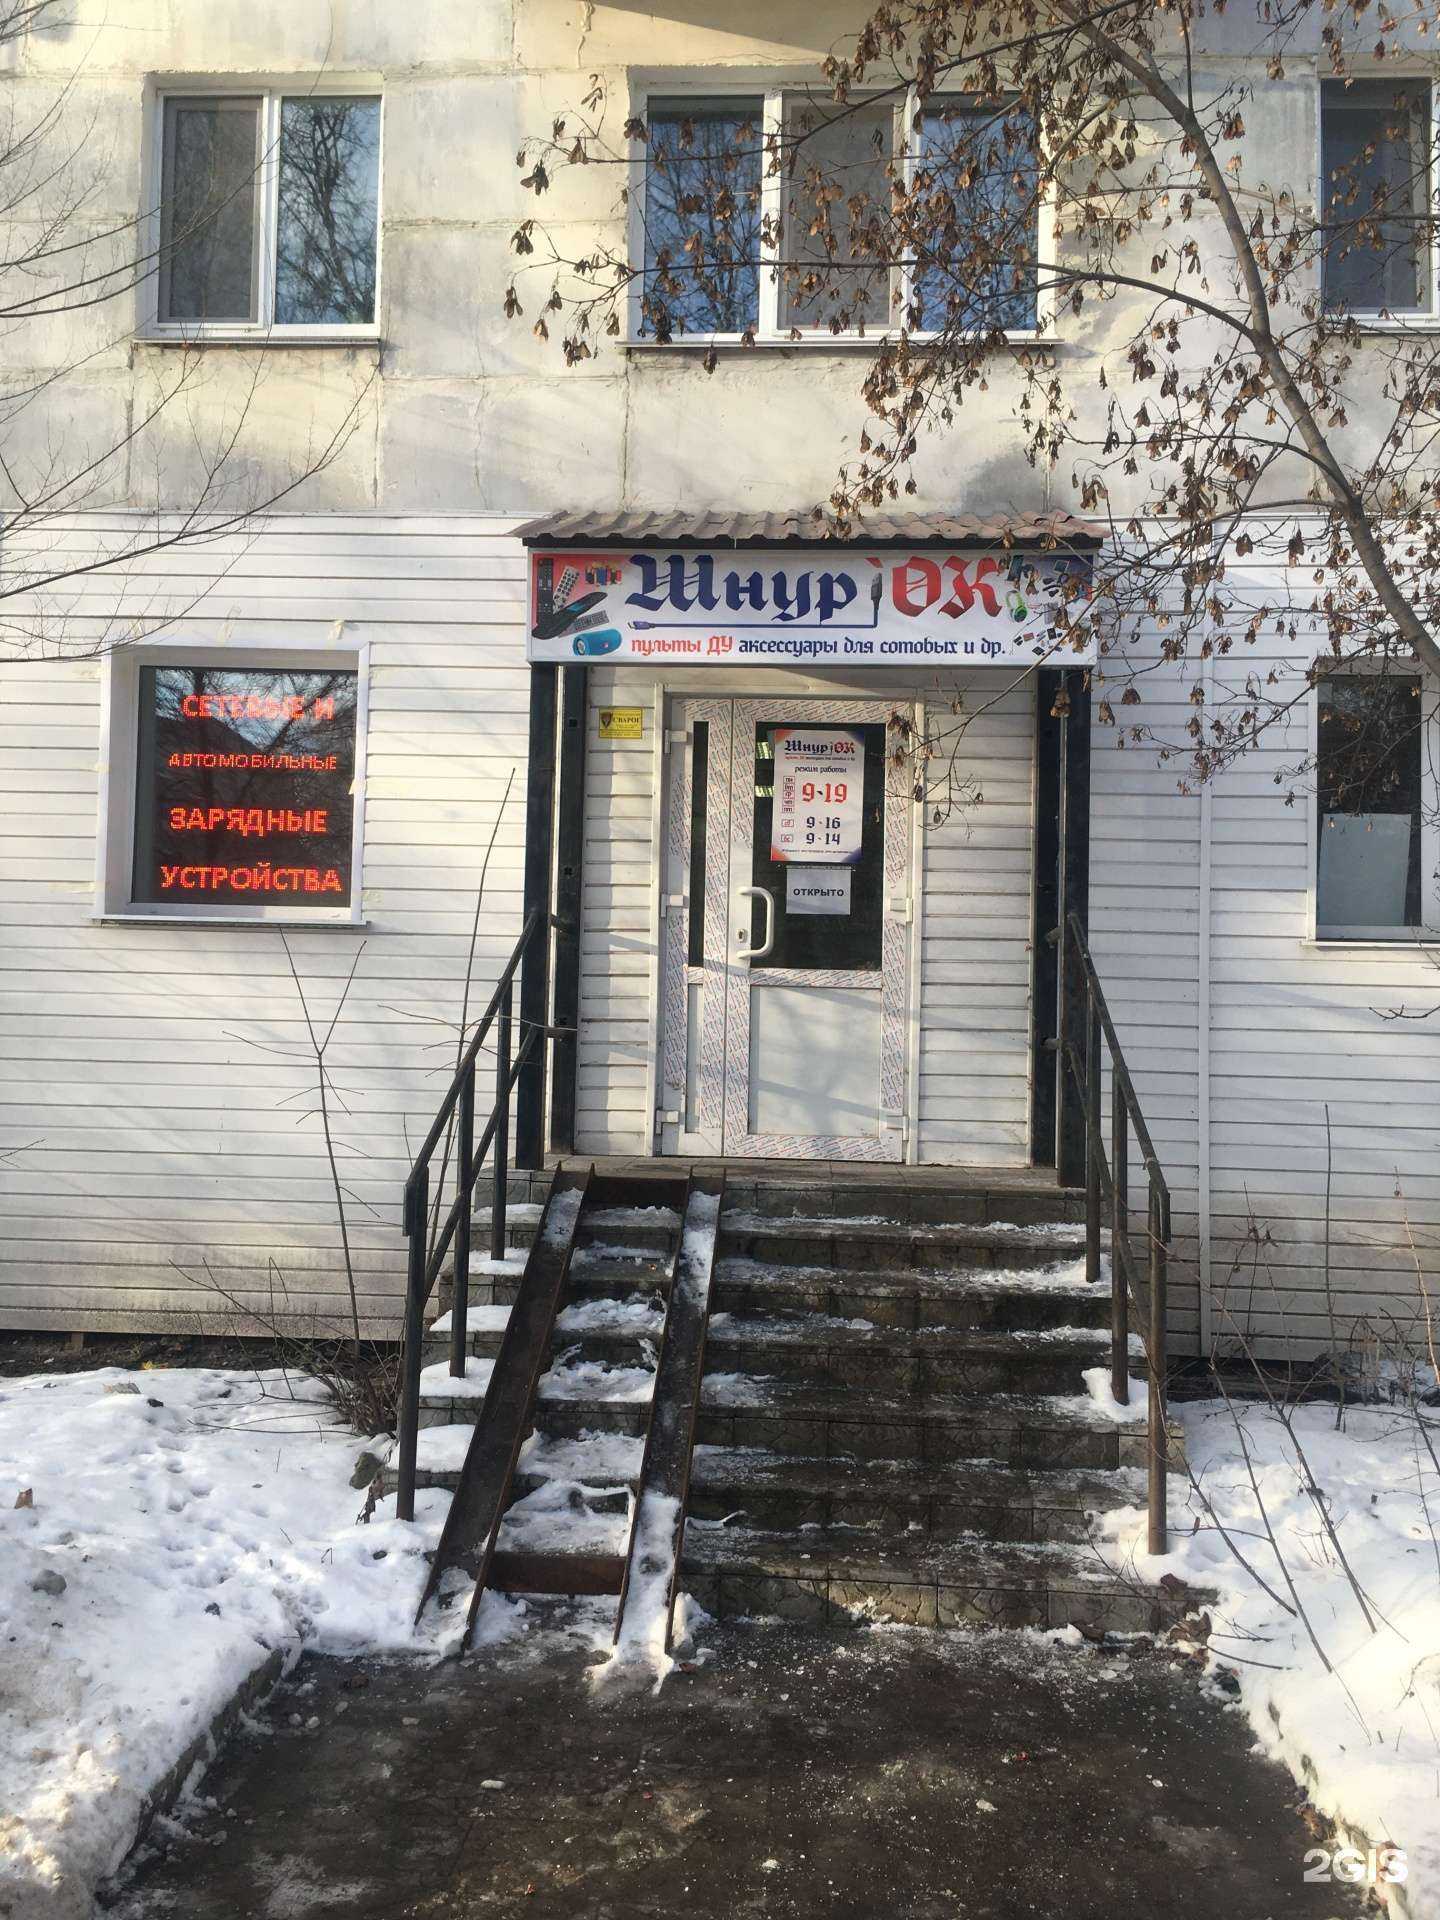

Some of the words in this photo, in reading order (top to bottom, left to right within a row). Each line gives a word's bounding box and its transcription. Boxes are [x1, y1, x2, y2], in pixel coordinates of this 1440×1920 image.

[631, 638, 702, 657] пульты
[706, 635, 736, 656] ДУ
[738, 639, 838, 658] аксессуары
[843, 636, 874, 655] для
[879, 636, 958, 655] сотовых
[963, 641, 975, 655] и
[980, 637, 1007, 658] др.
[182, 694, 306, 720] СЕТЕВЫЕ
[315, 696, 335, 721] И
[168, 752, 338, 771] АВТОМОБИЛЬНЫЕ
[168, 807, 328, 837] ЗАРЯДНЫЕ
[160, 862, 343, 893] УСТРОЙСТВА
[793, 887, 845, 898] ОТКРЫТО
